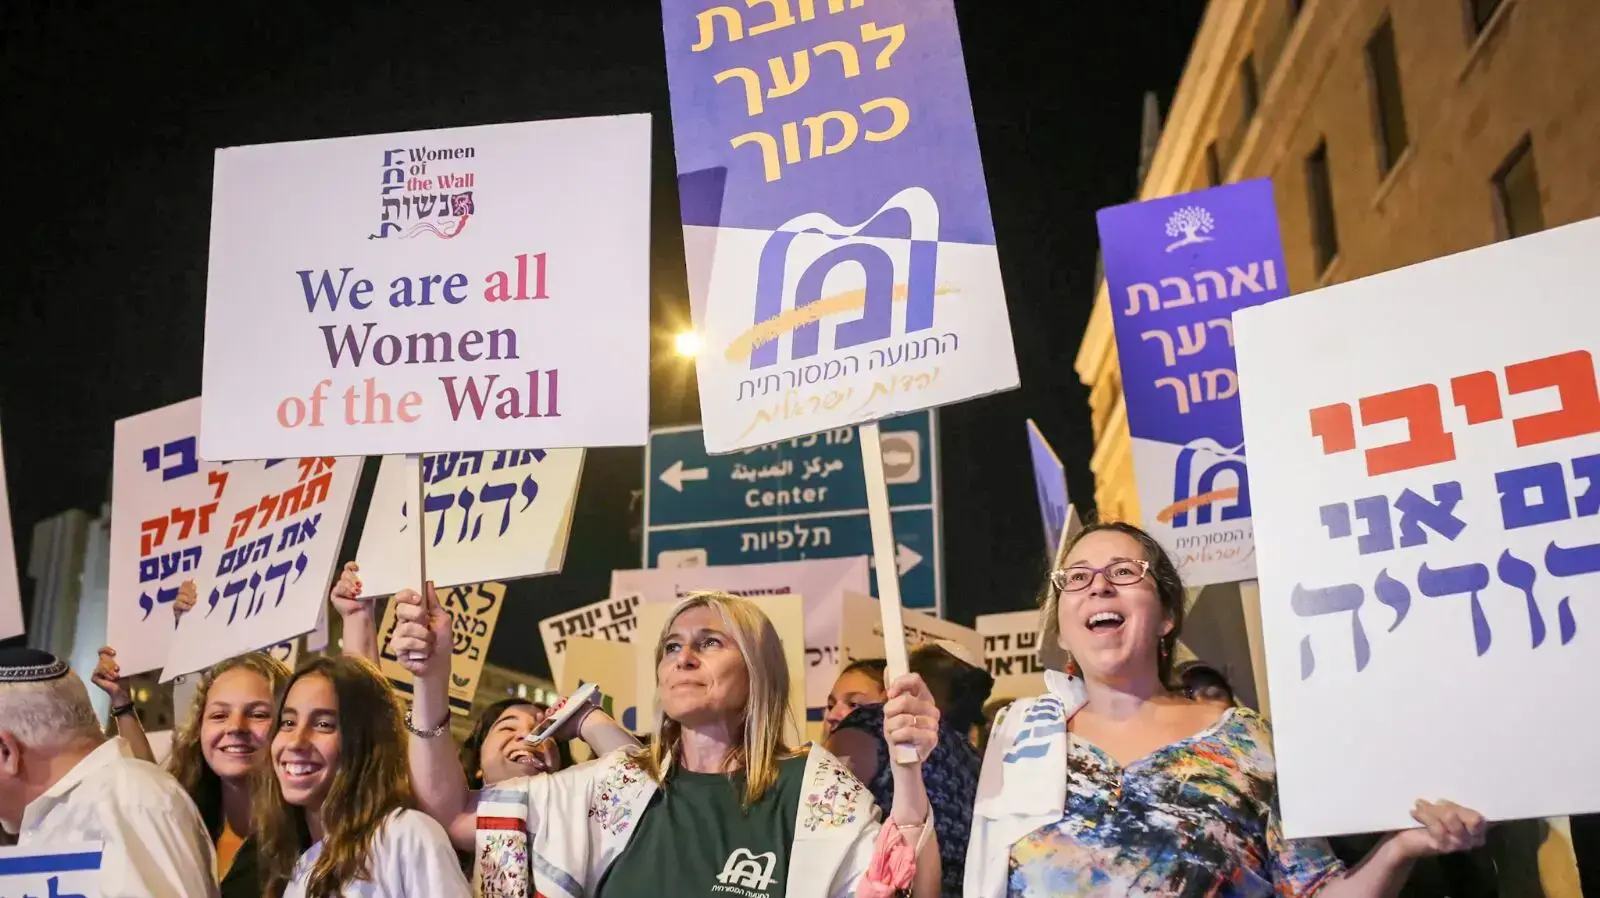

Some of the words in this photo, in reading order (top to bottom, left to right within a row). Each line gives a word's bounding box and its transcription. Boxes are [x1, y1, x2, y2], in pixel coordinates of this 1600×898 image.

[713, 22, 906, 116] לרעך
[409, 146, 475, 162] Women
[729, 96, 910, 182] כמוך
[407, 177, 433, 191] the
[437, 172, 474, 189] Wall
[409, 161, 427, 176] of
[296, 267, 374, 313] We
[388, 272, 469, 308] are
[483, 252, 550, 302] all
[1124, 259, 1278, 316] ואהבת
[318, 322, 520, 369] Women
[868, 332, 959, 370] התנועה
[1140, 318, 1236, 367] רעך
[276, 379, 334, 428] of
[342, 377, 423, 425] the
[438, 369, 561, 421] Wall
[736, 355, 859, 402] המסורתית
[1154, 368, 1239, 415] מוך
[1309, 350, 1600, 477] ביבי
[225, 472, 333, 550] תחלק
[745, 486, 828, 508] Center
[1319, 481, 1467, 555] אני
[215, 533, 274, 578] העם
[276, 512, 322, 553] את
[740, 521, 832, 553] תלפיות
[205, 551, 308, 627] יהודי
[1290, 540, 1600, 682] הודיה
